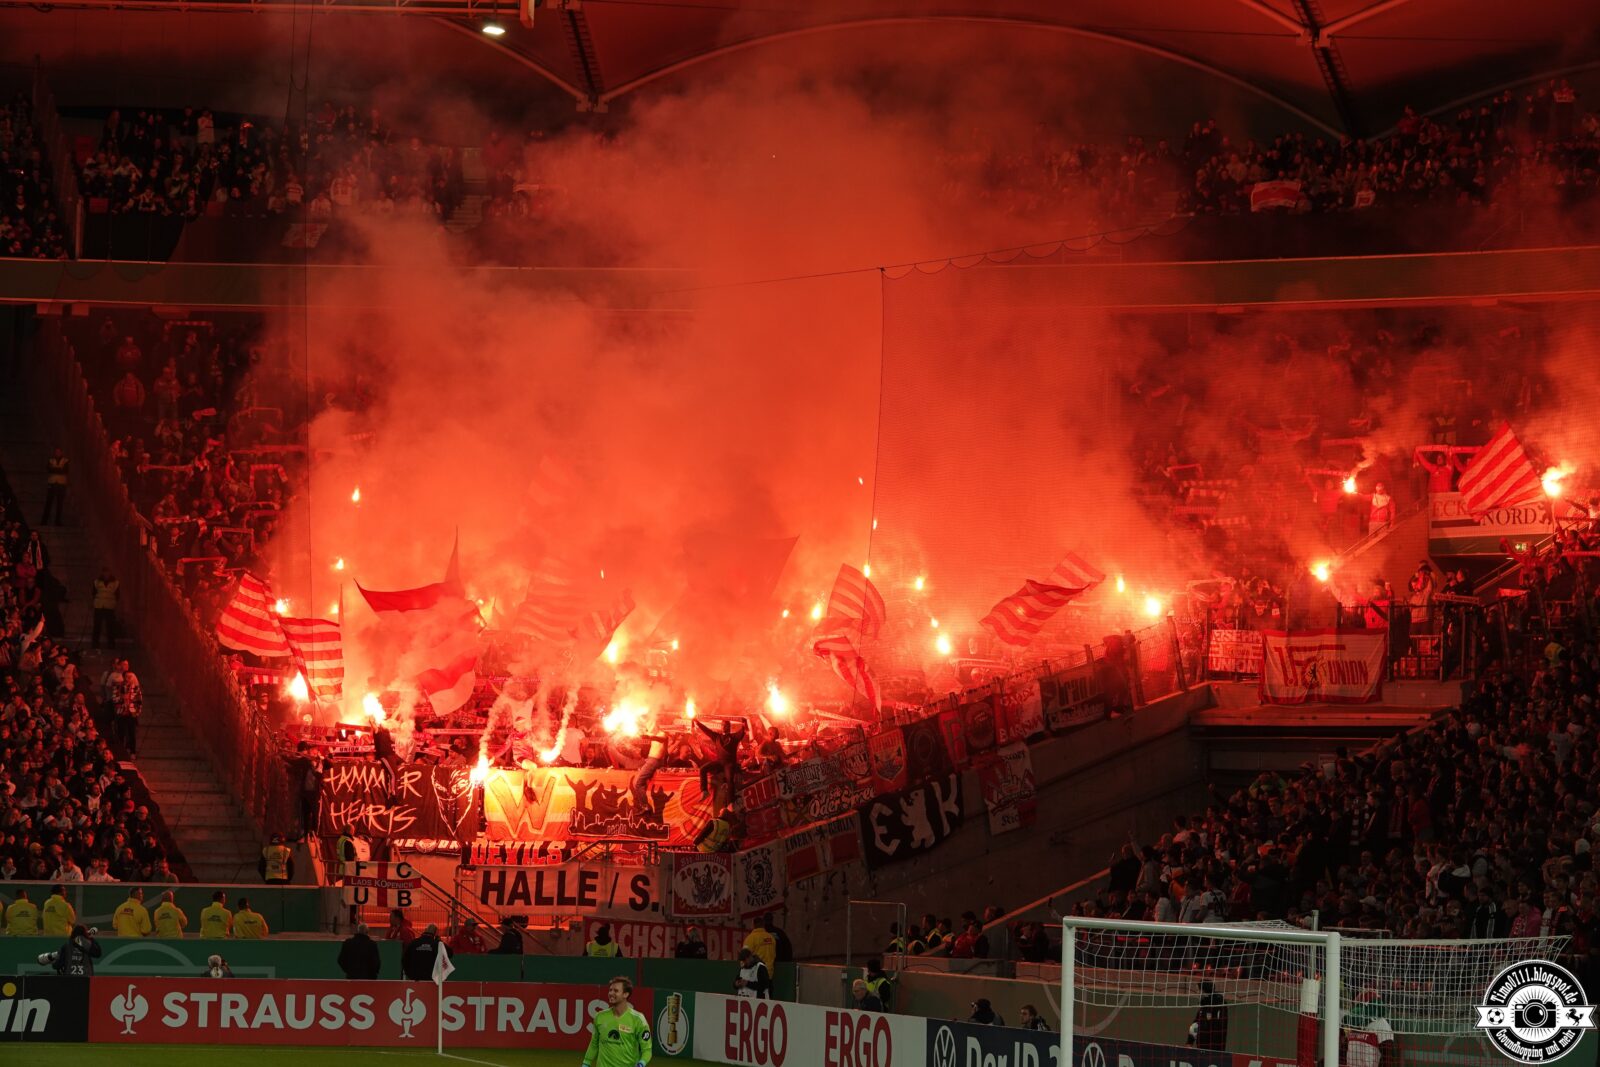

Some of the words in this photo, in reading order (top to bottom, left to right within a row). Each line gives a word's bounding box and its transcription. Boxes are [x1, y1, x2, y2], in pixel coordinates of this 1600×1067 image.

[1482, 508, 1537, 526] NORD
[1327, 660, 1369, 686] UNION
[324, 765, 422, 799] HAMMR
[330, 799, 417, 834] HEARTS
[868, 802, 901, 855] E
[470, 839, 566, 866] DEVILS
[480, 869, 600, 907] HALLE
[629, 874, 660, 913] S.
[162, 991, 376, 1030] STRAUSS
[725, 1000, 788, 1067] ERGO
[825, 1010, 892, 1067] ERGO
